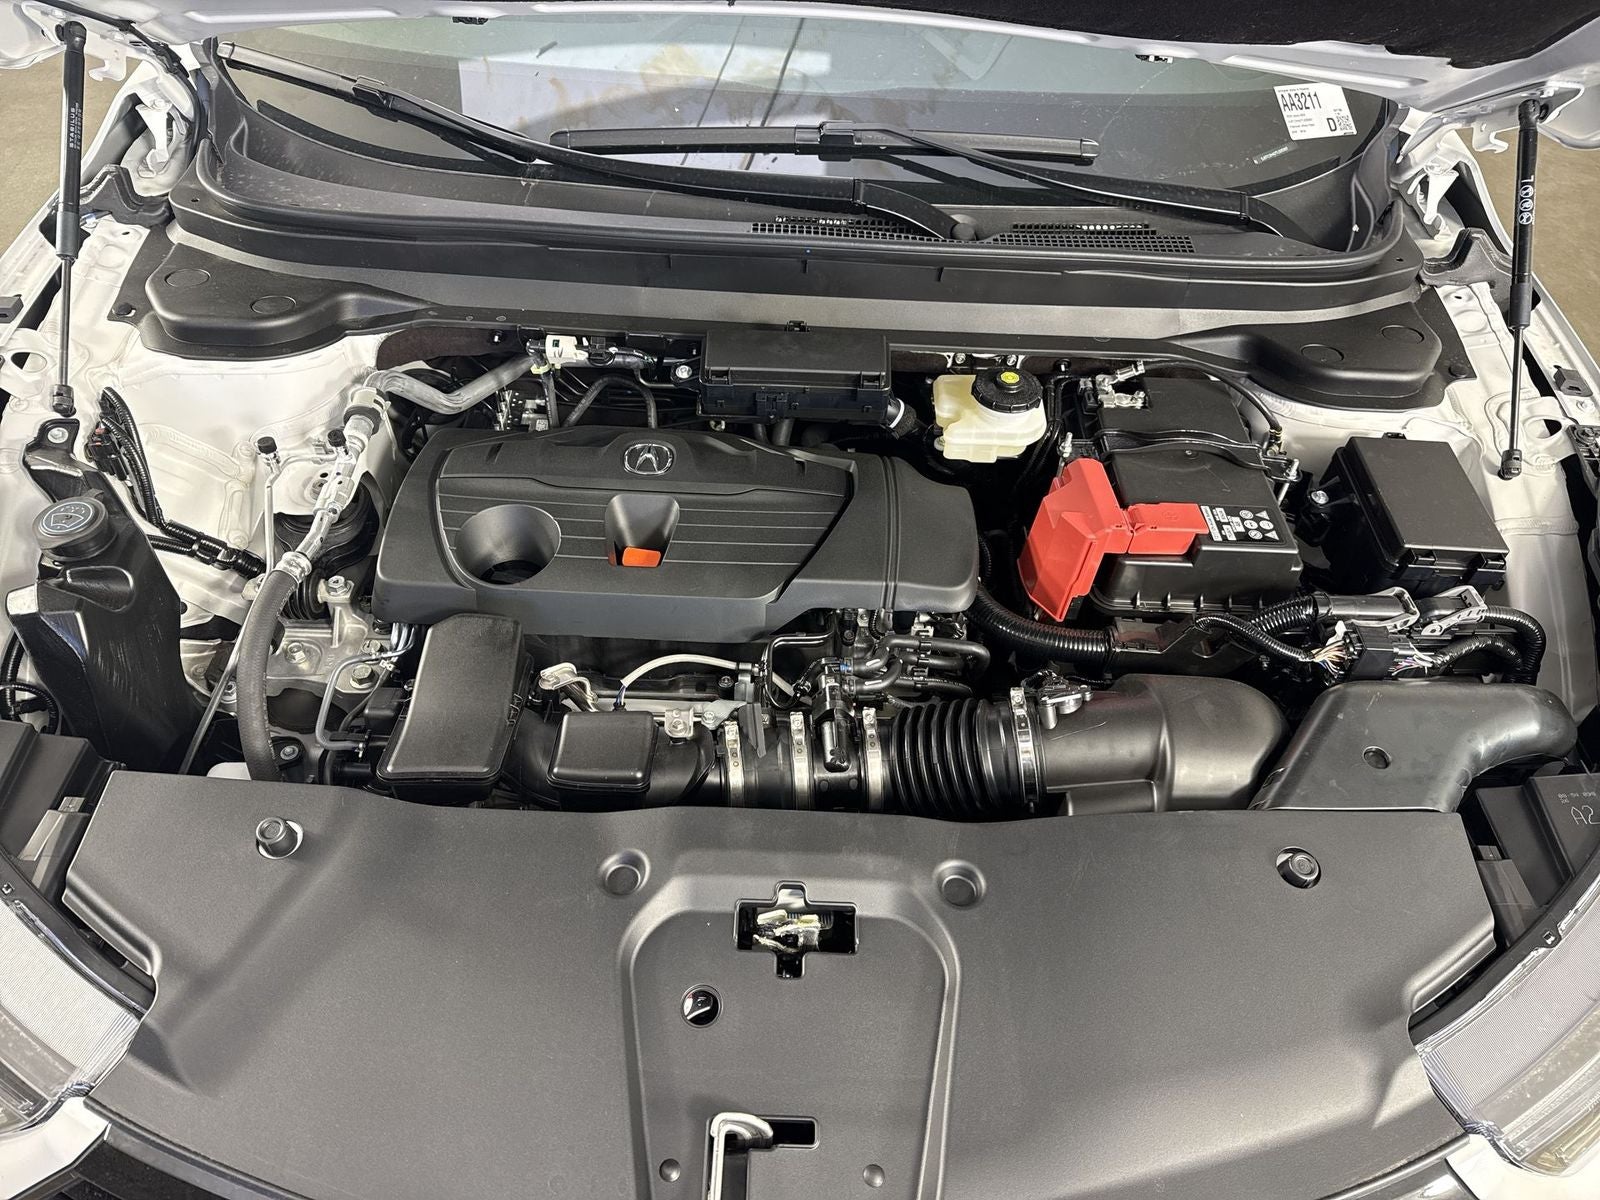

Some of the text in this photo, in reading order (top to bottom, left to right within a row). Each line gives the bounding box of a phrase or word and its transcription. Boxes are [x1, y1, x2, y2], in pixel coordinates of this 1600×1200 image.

[1280, 91, 1322, 112] AA3211
[1326, 117, 1337, 132] D
[1570, 804, 1600, 825] A2
